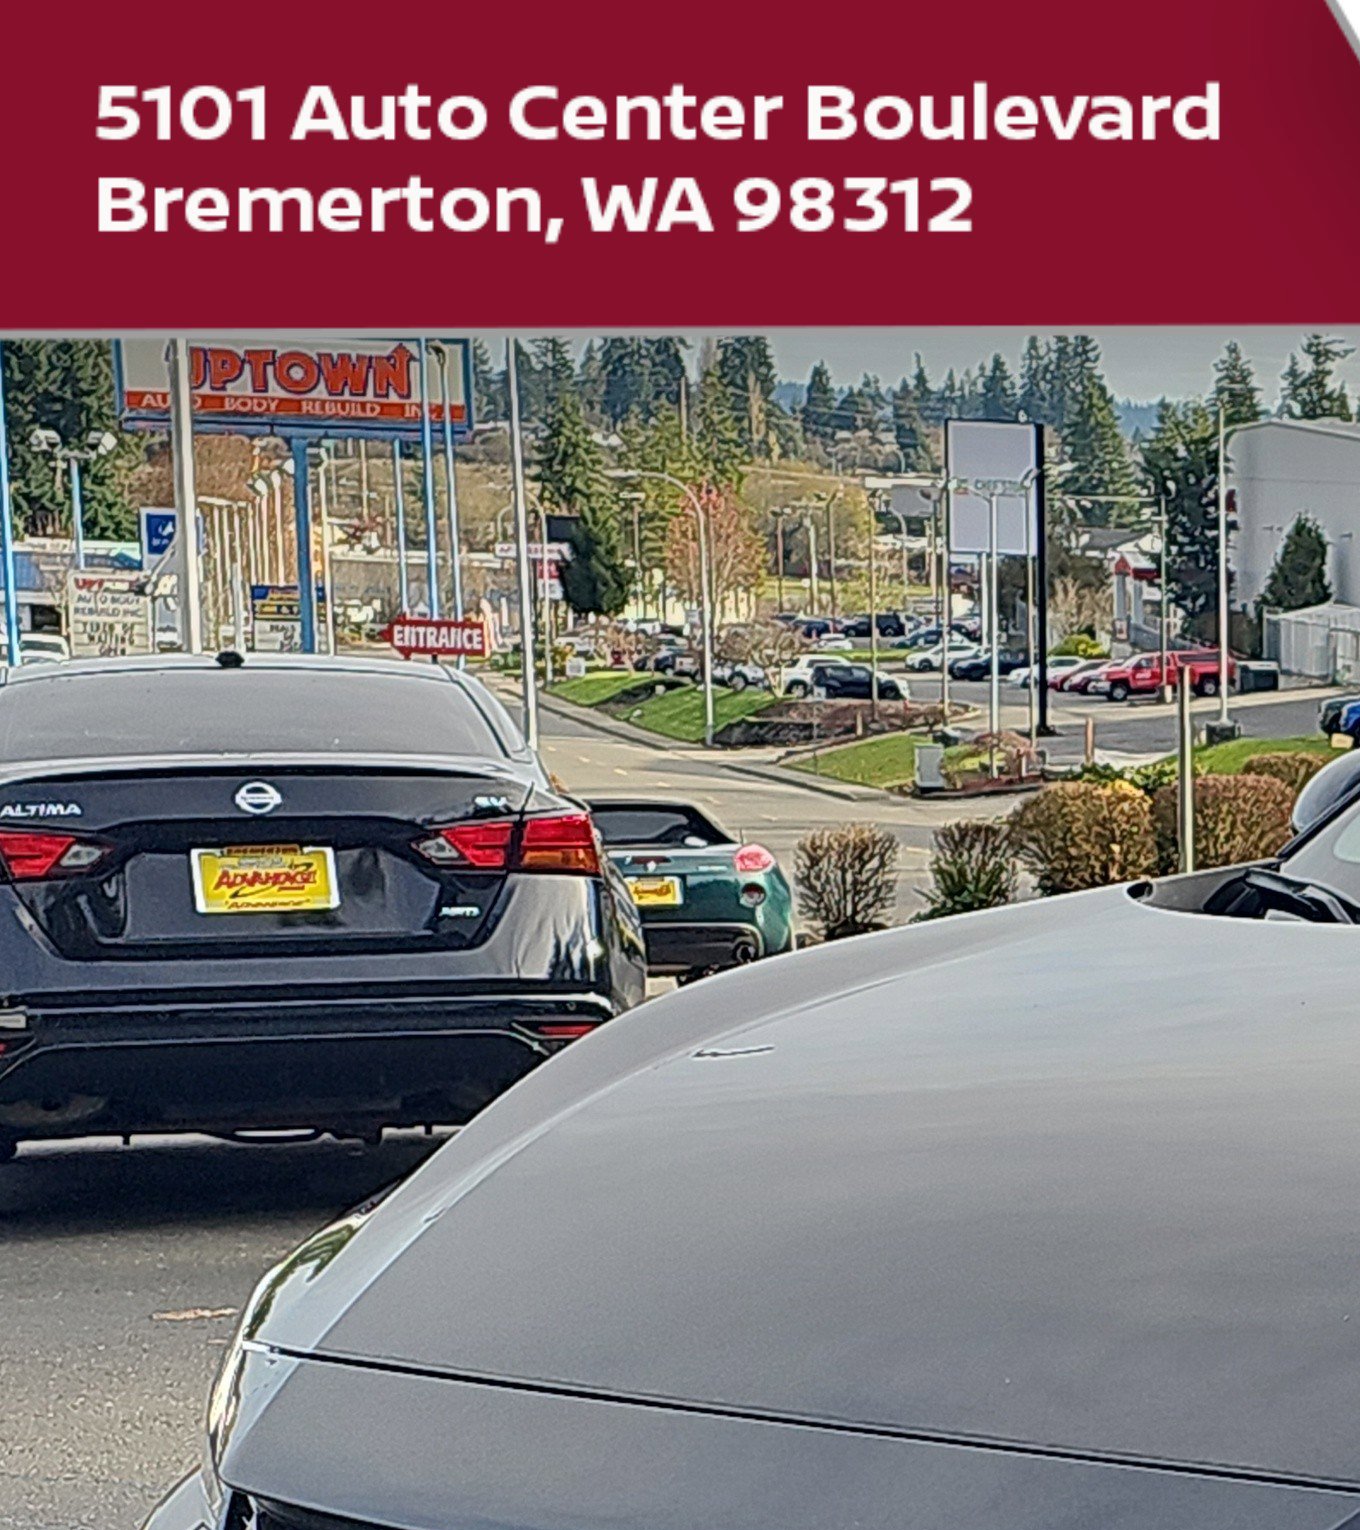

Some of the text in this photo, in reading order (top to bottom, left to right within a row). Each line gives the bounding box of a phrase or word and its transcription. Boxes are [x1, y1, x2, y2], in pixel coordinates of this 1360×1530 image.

[224, 397, 280, 413] BODY
[301, 400, 380, 417] REBUILD
[393, 625, 482, 650] ENTRANCE
[0, 803, 82, 818] ALTIMA
